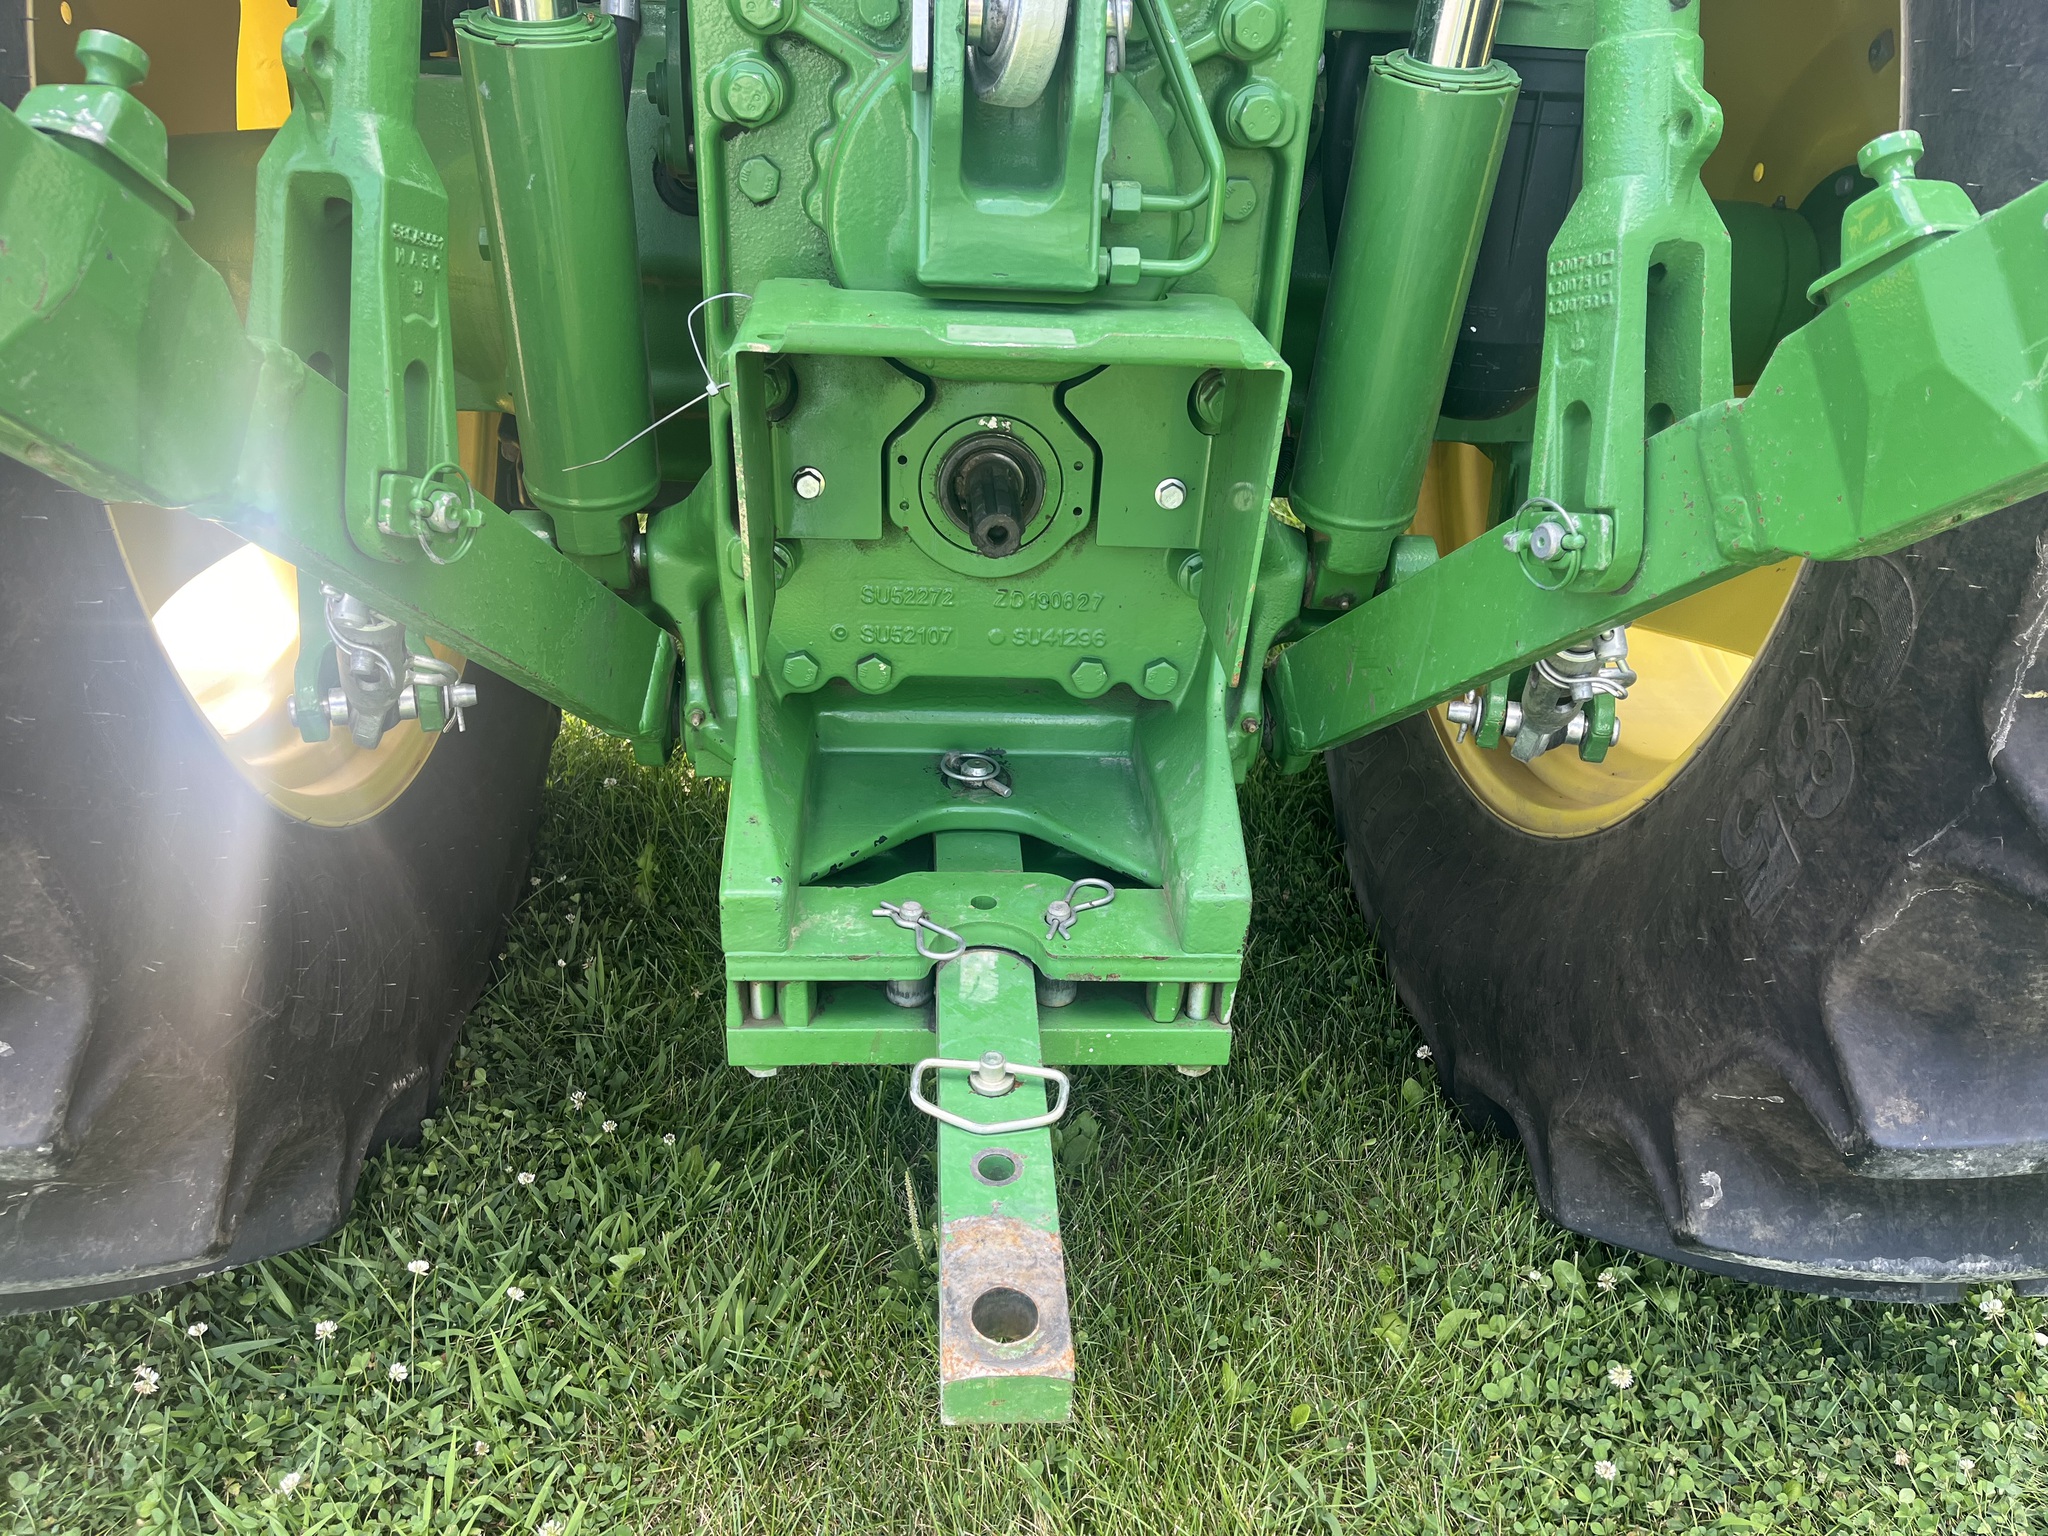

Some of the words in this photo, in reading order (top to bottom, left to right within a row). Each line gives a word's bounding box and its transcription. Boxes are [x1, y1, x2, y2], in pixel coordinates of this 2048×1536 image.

[860, 584, 955, 608] SU52272
[860, 624, 953, 645] SU52107
[1012, 627, 1107, 648] SU41296
